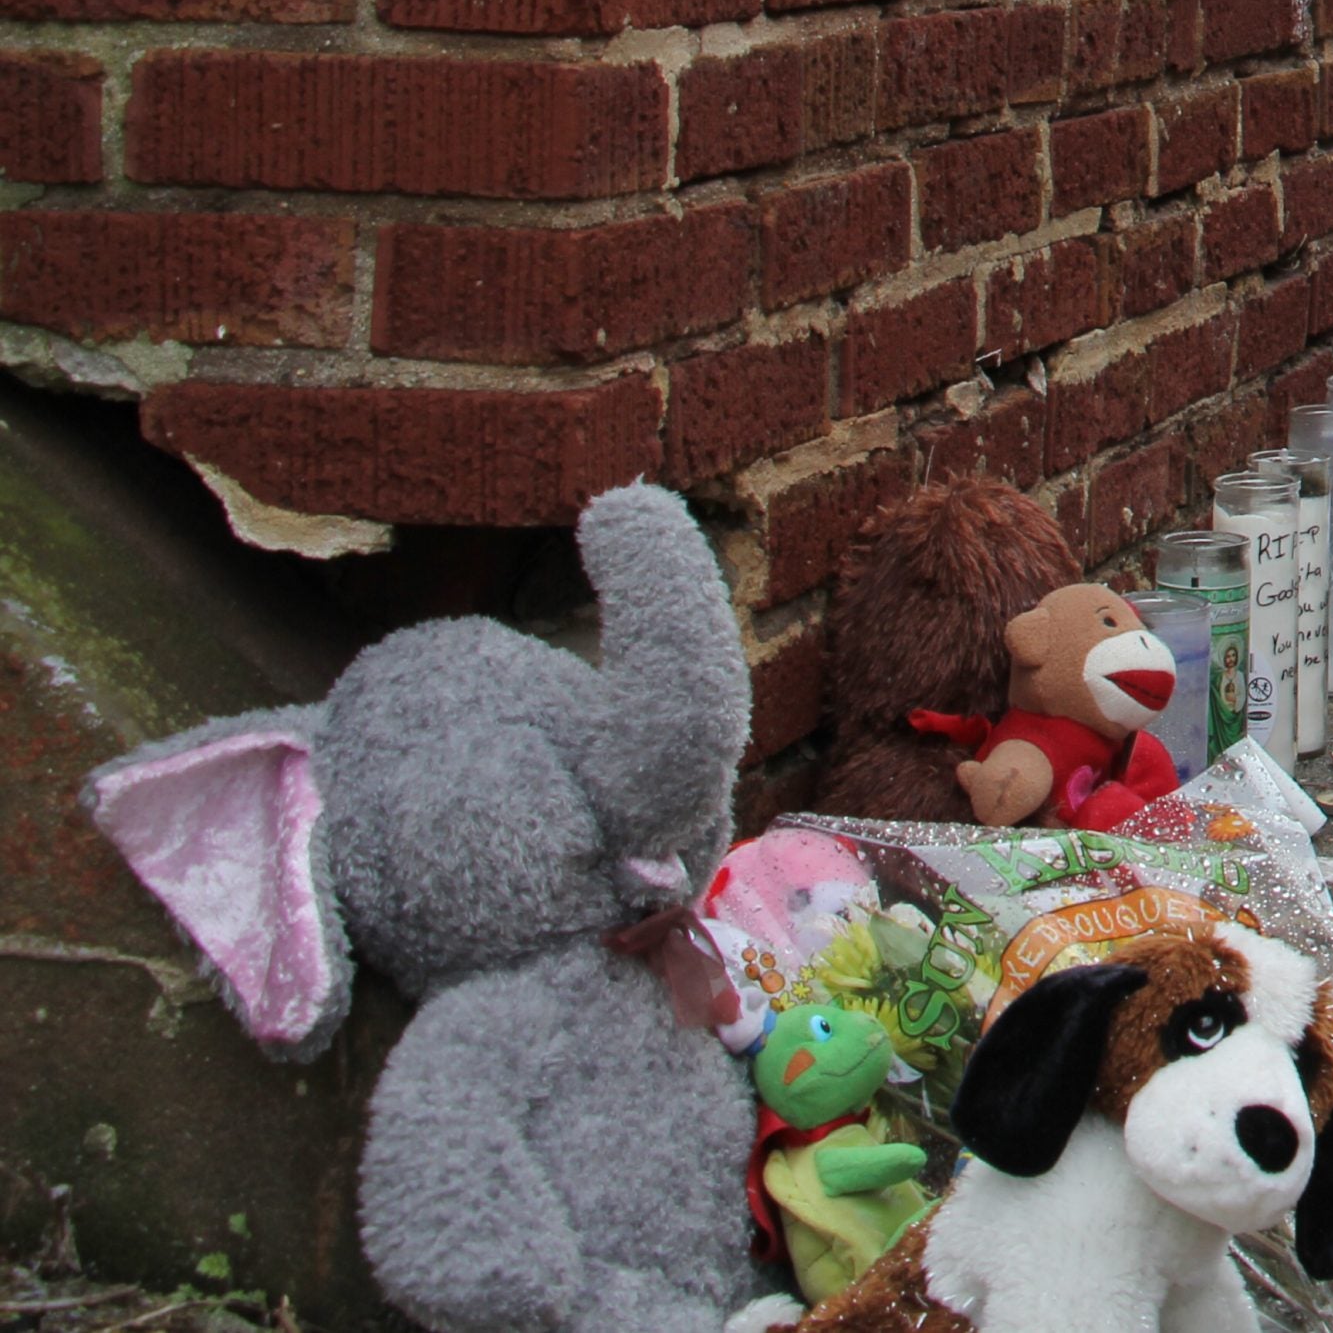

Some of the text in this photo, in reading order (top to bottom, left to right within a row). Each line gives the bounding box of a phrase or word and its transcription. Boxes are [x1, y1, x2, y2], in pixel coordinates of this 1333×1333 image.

[899, 883, 993, 1050] SUN
[966, 830, 1251, 896] KISSED
[1059, 893, 1213, 939] BOUQUET
